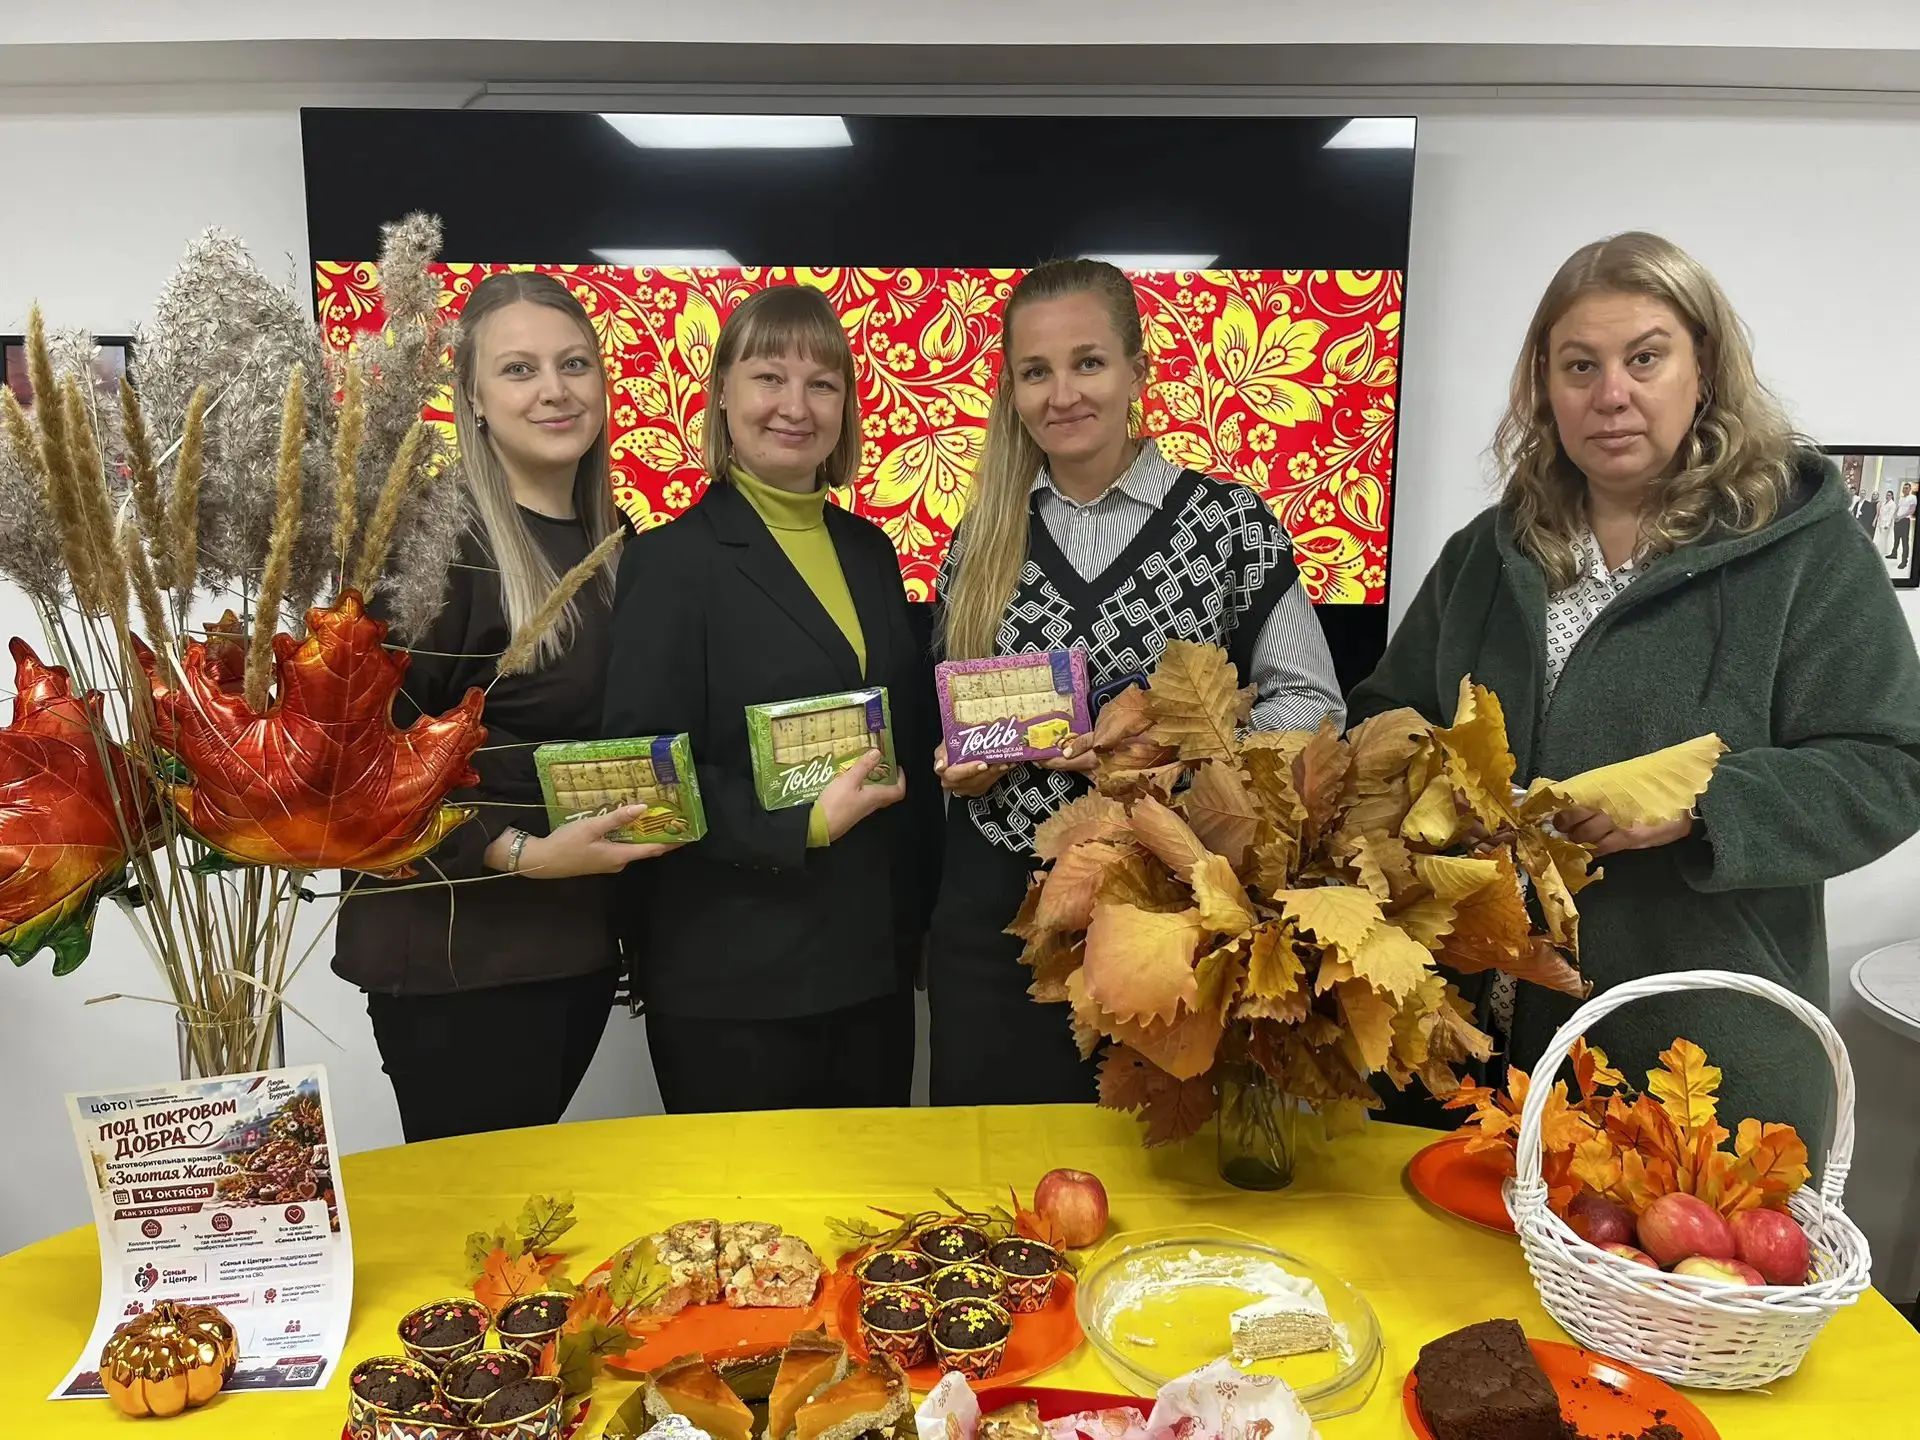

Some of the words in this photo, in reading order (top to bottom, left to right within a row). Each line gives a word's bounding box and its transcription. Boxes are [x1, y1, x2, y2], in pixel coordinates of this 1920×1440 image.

[958, 716, 1018, 756] Tolib
[779, 754, 834, 797] Tolib
[91, 1101, 127, 1114] ЦФТО
[99, 1118, 139, 1142] ПОД
[143, 1099, 237, 1130] ПОКРОВОМ
[114, 1127, 187, 1161] ДОБРА
[106, 1157, 186, 1170] Благотворительная
[187, 1154, 223, 1164] ярмарка
[108, 1169, 180, 1185] «Золотая
[182, 1162, 239, 1179] Жатва»
[138, 1190, 153, 1200] 14
[156, 1185, 209, 1199] октября
[162, 1269, 187, 1277] Семья
[169, 1275, 198, 1285] Центре
